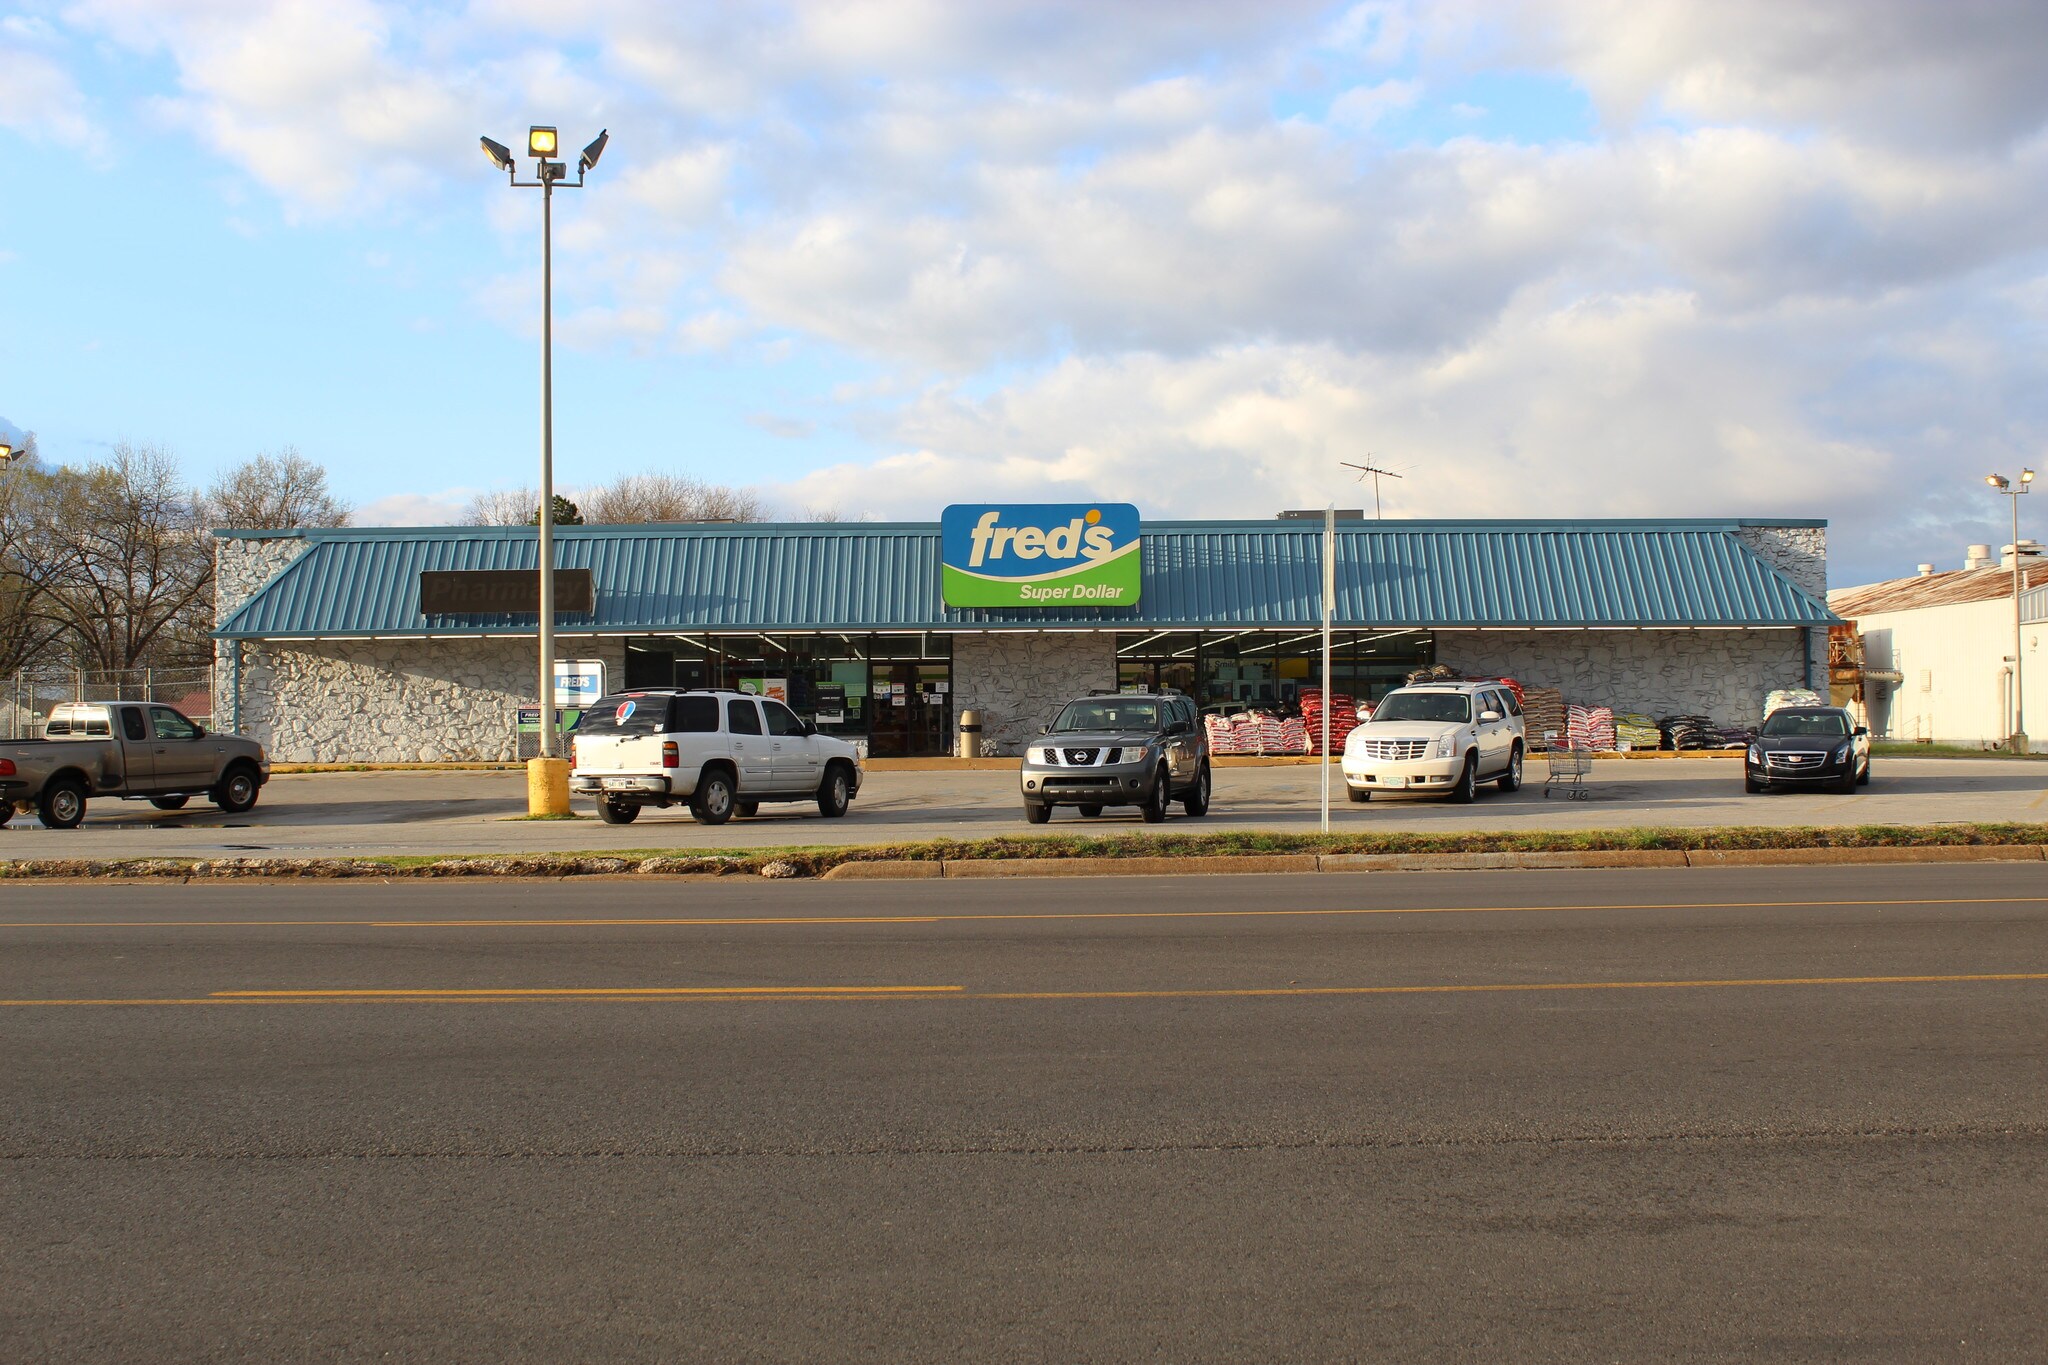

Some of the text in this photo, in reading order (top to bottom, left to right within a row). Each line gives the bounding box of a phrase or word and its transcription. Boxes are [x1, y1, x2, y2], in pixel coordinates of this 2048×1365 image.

[968, 509, 1115, 567] fred's
[1020, 584, 1124, 602] Super Dollar
[560, 676, 590, 688] FRED'S
